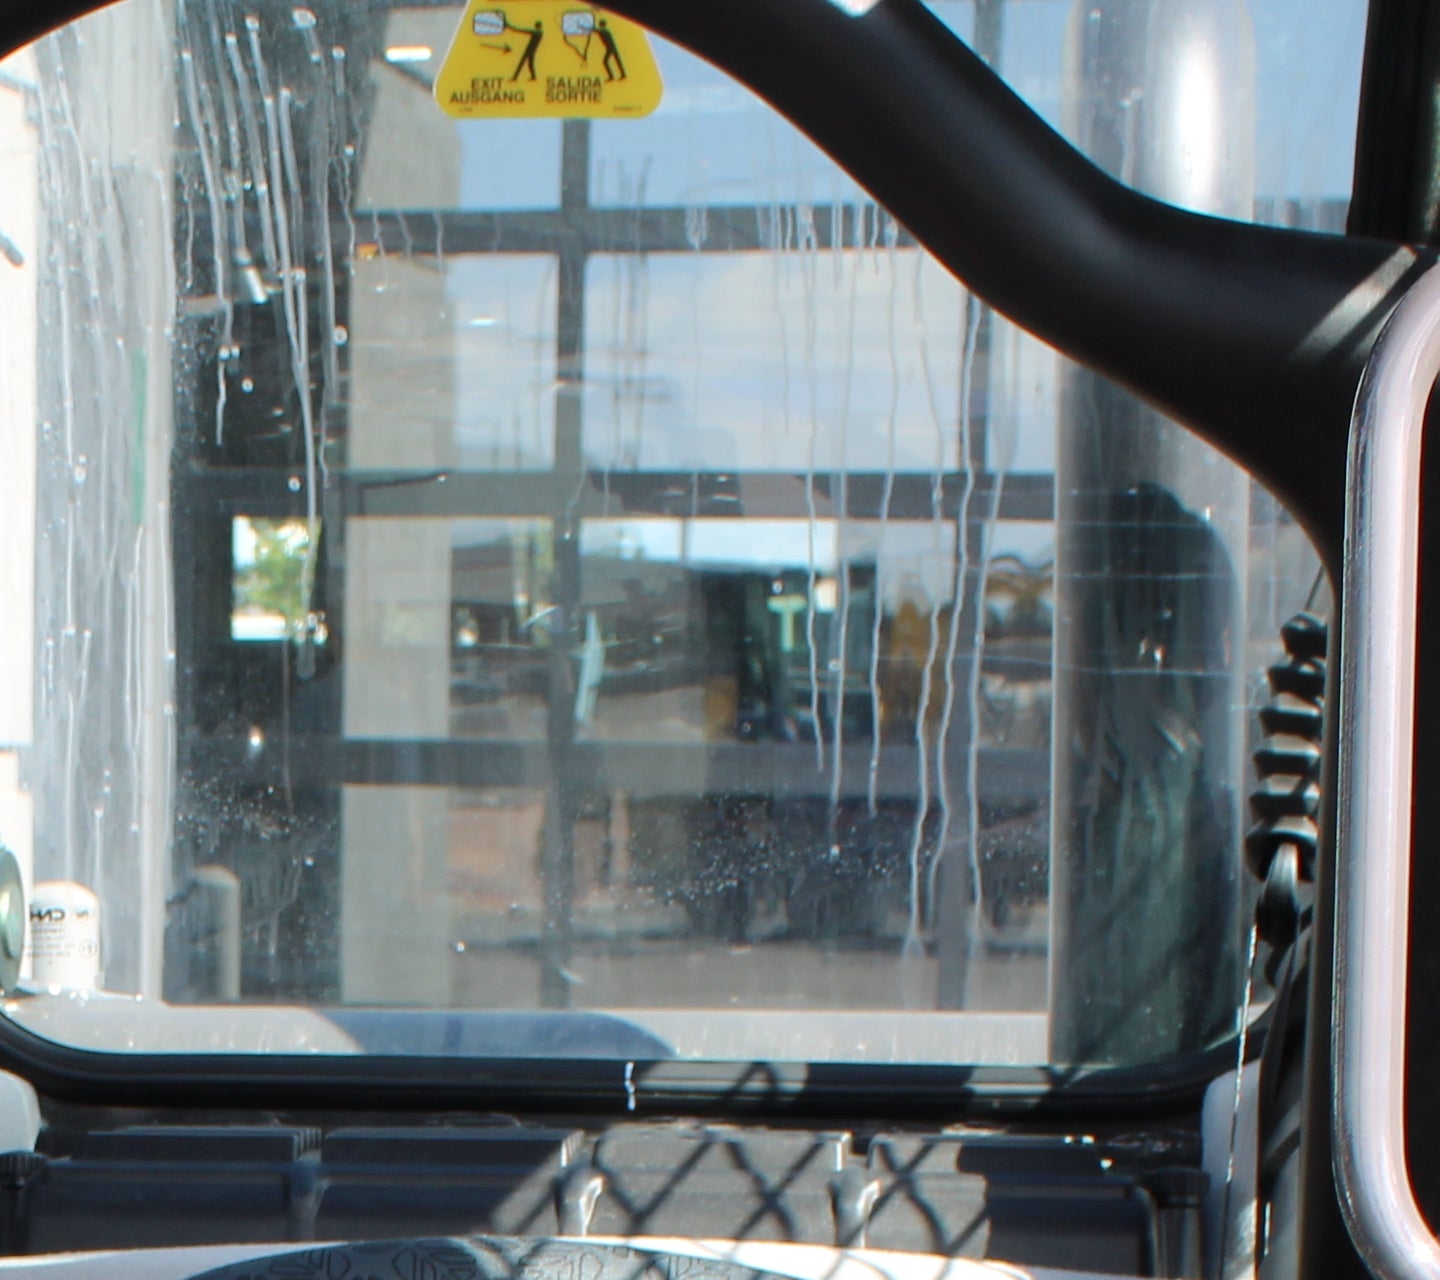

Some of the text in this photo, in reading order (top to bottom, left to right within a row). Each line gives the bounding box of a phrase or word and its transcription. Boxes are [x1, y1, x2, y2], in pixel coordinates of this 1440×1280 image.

[471, 76, 602, 90] EXIT SALIDA
[450, 89, 602, 103] AUSGANG SORTIE
